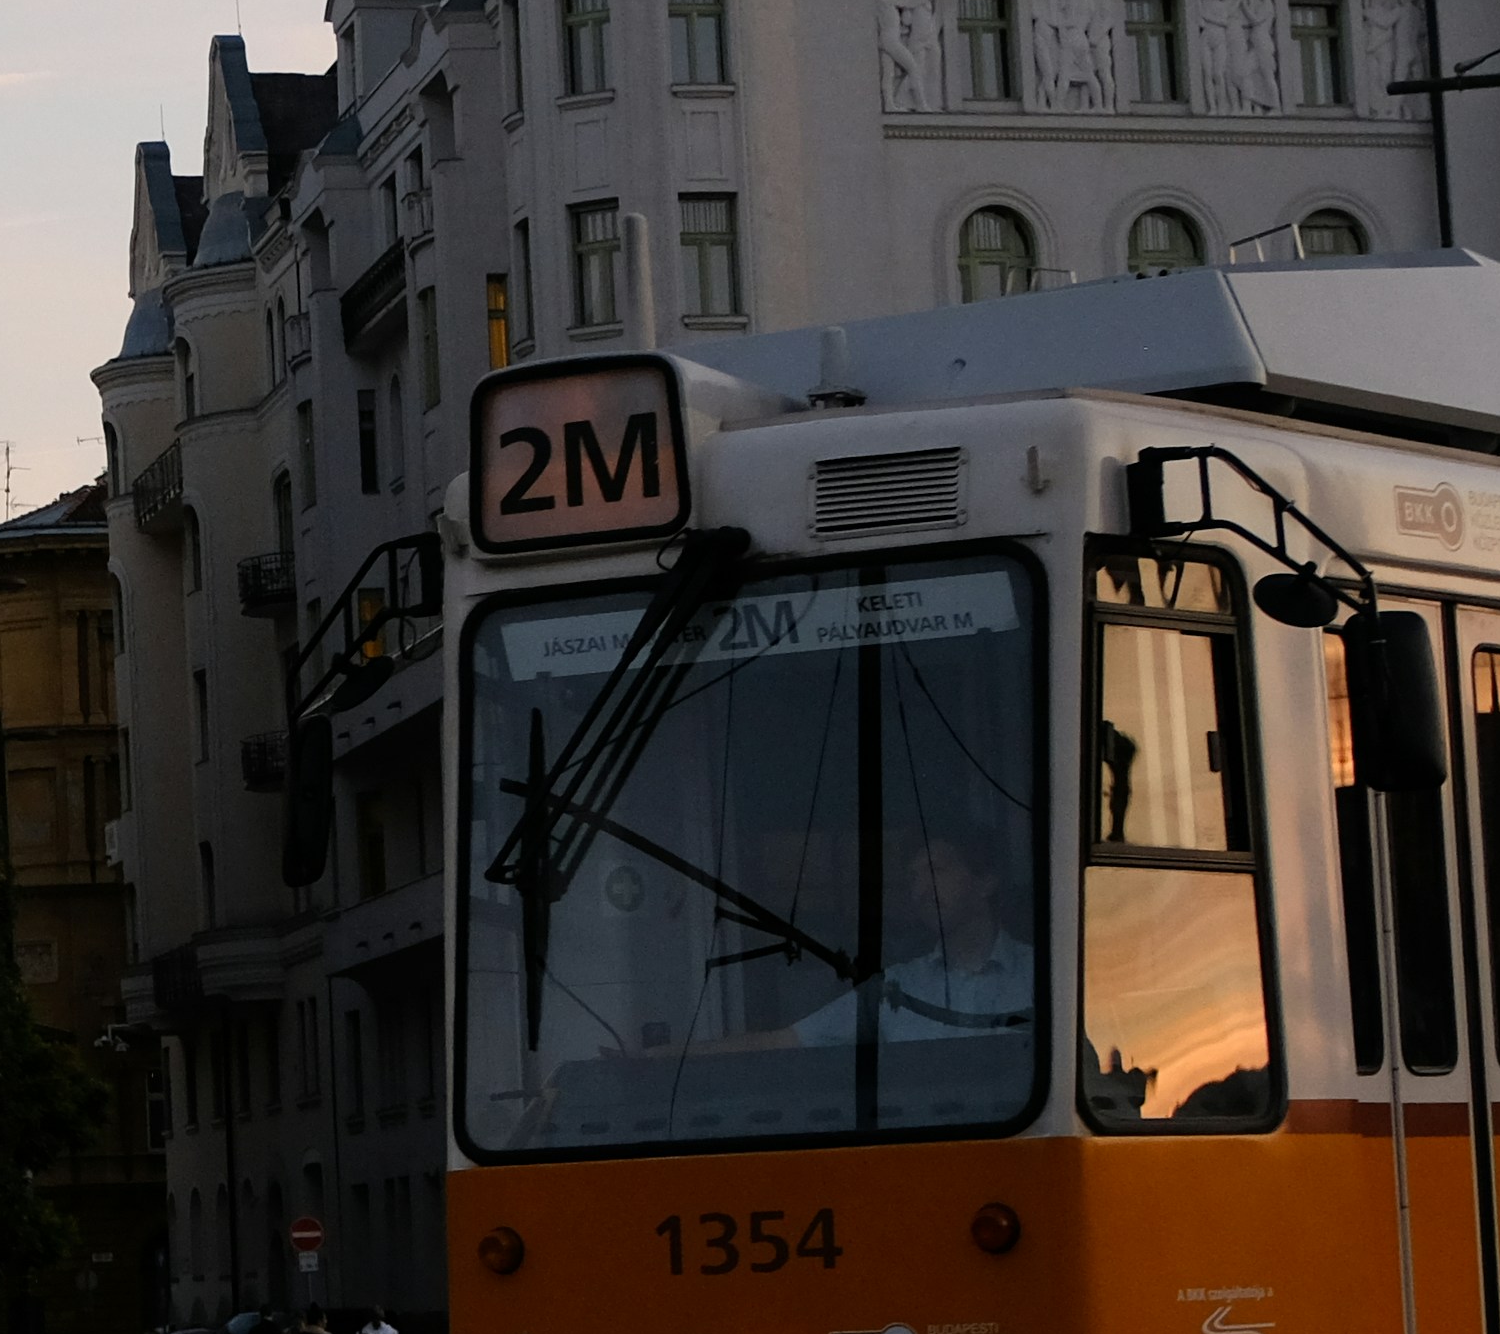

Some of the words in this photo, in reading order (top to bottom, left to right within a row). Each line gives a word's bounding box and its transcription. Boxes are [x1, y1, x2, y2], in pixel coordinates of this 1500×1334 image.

[499, 412, 661, 517] 2M
[1404, 501, 1435, 524] BKK
[859, 592, 922, 613] KELETI
[713, 601, 799, 651] 2M
[817, 614, 947, 643] PÁLYAUDVAR
[953, 612, 974, 629] M
[544, 635, 606, 657] JÁSZAI
[655, 1208, 843, 1276] 1354
